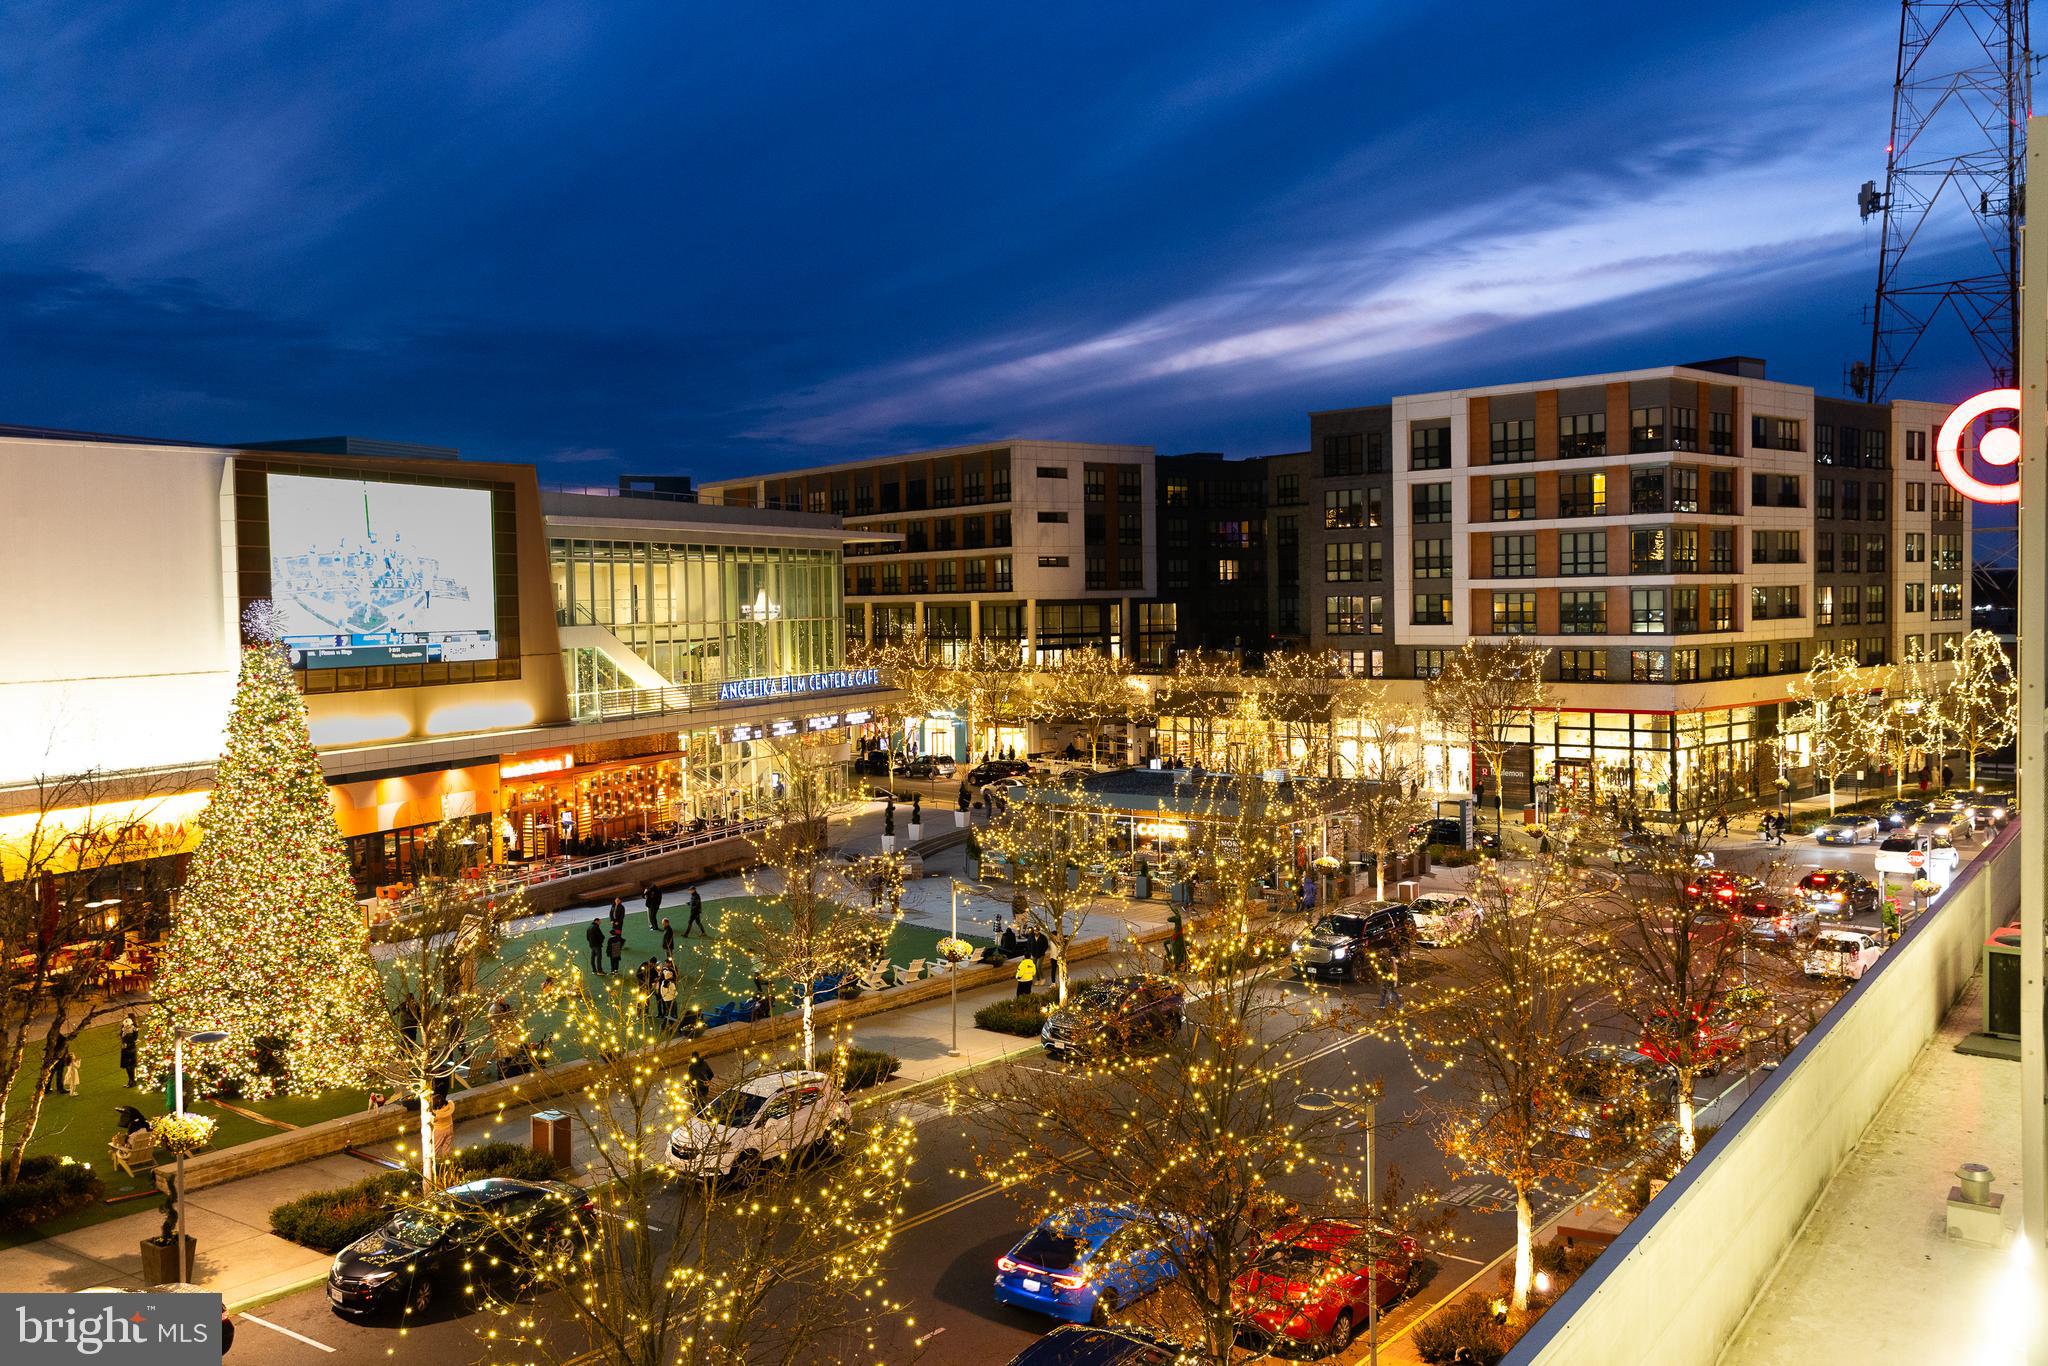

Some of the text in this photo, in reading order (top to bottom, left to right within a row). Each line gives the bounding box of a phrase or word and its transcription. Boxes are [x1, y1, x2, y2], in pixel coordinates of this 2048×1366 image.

[721, 669, 879, 700] ANGELIKA FILM CENTER & CAFE
[1491, 768, 1523, 777] lulemon
[1137, 823, 1187, 838] COFFEE
[1906, 855, 1925, 863] STOP
